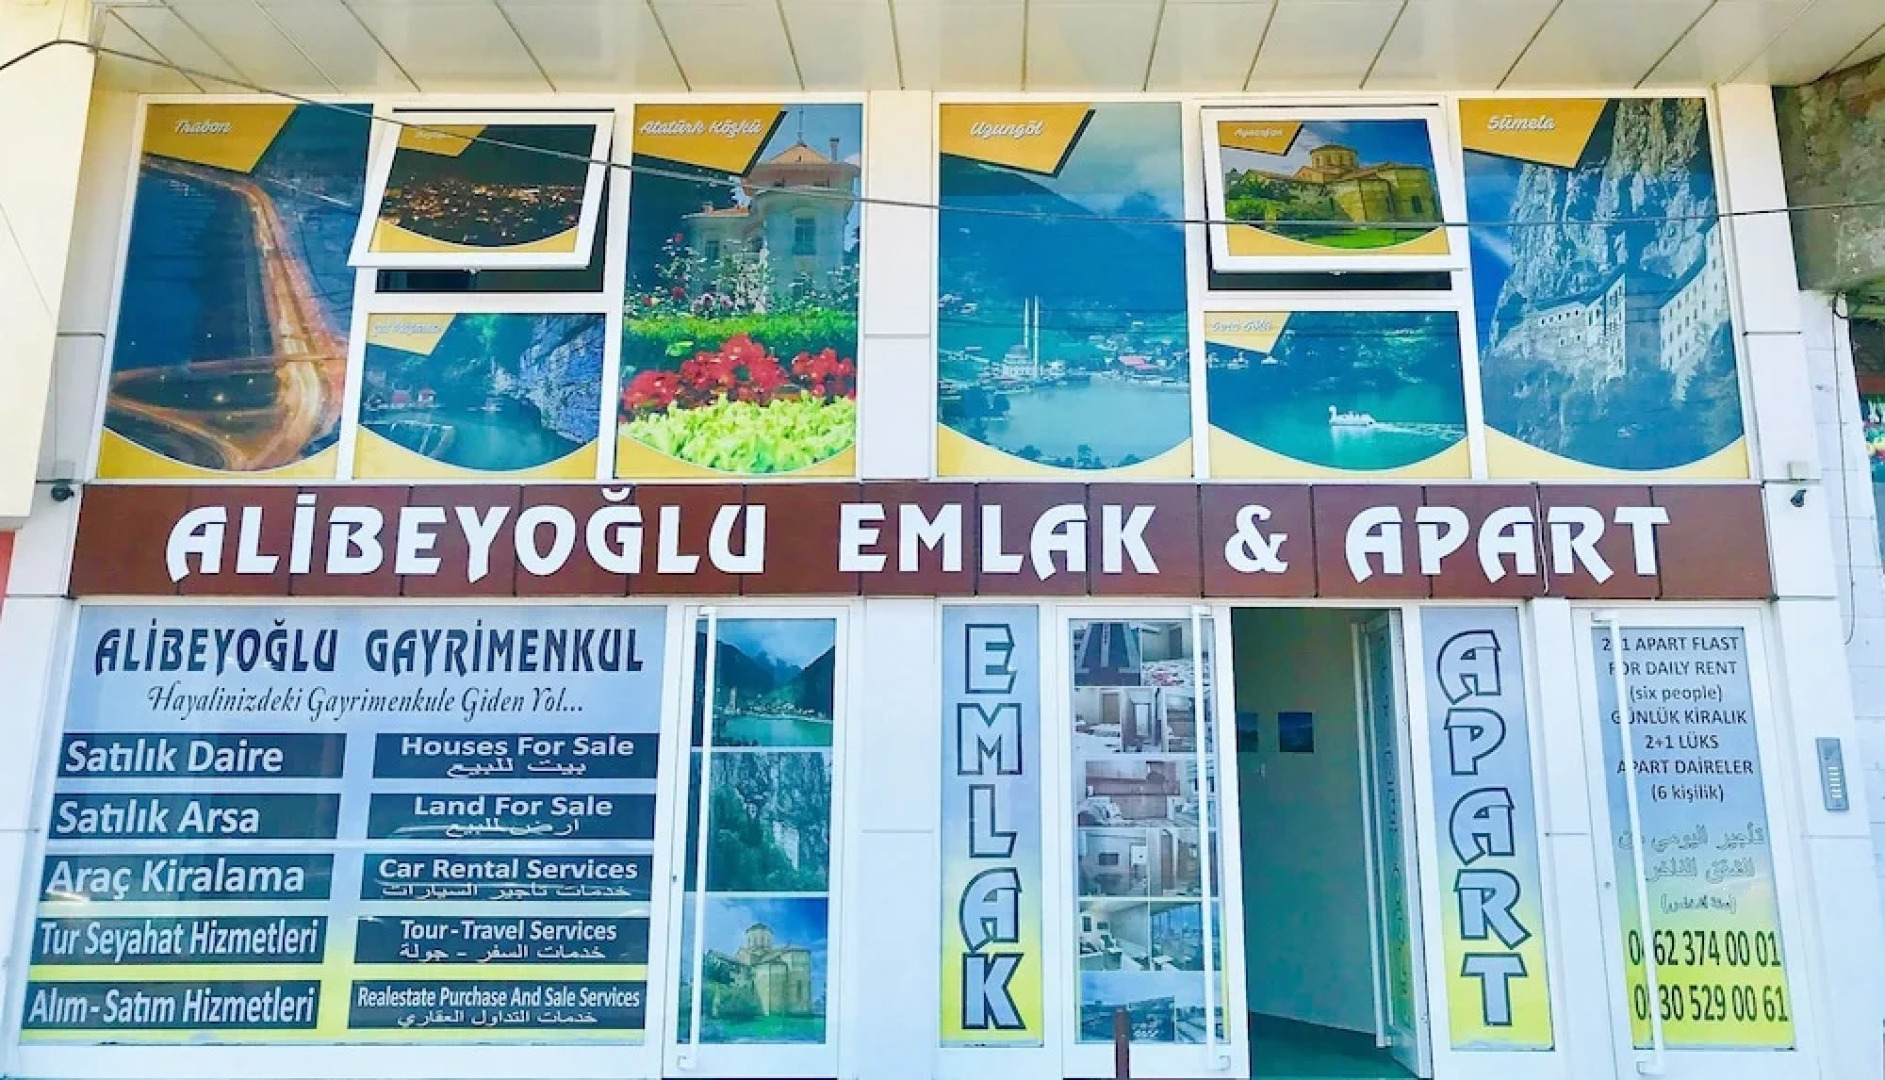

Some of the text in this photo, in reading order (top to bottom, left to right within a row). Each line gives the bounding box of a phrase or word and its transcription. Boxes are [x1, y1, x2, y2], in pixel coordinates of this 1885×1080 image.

[1487, 113, 1555, 131] Sümela
[165, 487, 1671, 583] ALİBEYOĞLU EMLAK & APART
[96, 618, 644, 677] ALİBEYOĞLU GAYRİMENKUL
[1601, 637, 1739, 651] 21 APART FLAST
[1646, 661, 1689, 676] DAILY
[1696, 661, 1737, 676] RENT
[148, 682, 302, 721] Hayalinizdeki
[308, 685, 455, 722] Gayrimenkule
[462, 684, 523, 716] Giden
[1629, 684, 1722, 703] (six people)
[1685, 706, 1747, 725] KİRALIK
[401, 735, 634, 756] Houses For Sale
[1645, 730, 1719, 750] 2+1 LÜKS
[65, 738, 284, 772] Satılık Daire
[1675, 755, 1753, 774] DAİRELER
[414, 795, 613, 816] Land For Sale
[1672, 784, 1724, 804] kişilik)
[56, 799, 260, 834] Satılık Arsa
[957, 624, 1027, 1030] EMLAK
[1437, 629, 1532, 1027] APART
[46, 857, 305, 899] Araç Kiralama
[379, 858, 638, 879] Car Rental Services
[41, 918, 319, 963] Tur Seyahat Hizmetleri
[529, 919, 618, 941] Services
[1628, 929, 1782, 967] 062 374 00 01
[182, 985, 315, 1024] Hizmetleri
[357, 985, 640, 1008] Realestate Purchase And Sale Services
[1634, 984, 1790, 1022] 030 529 00 61
